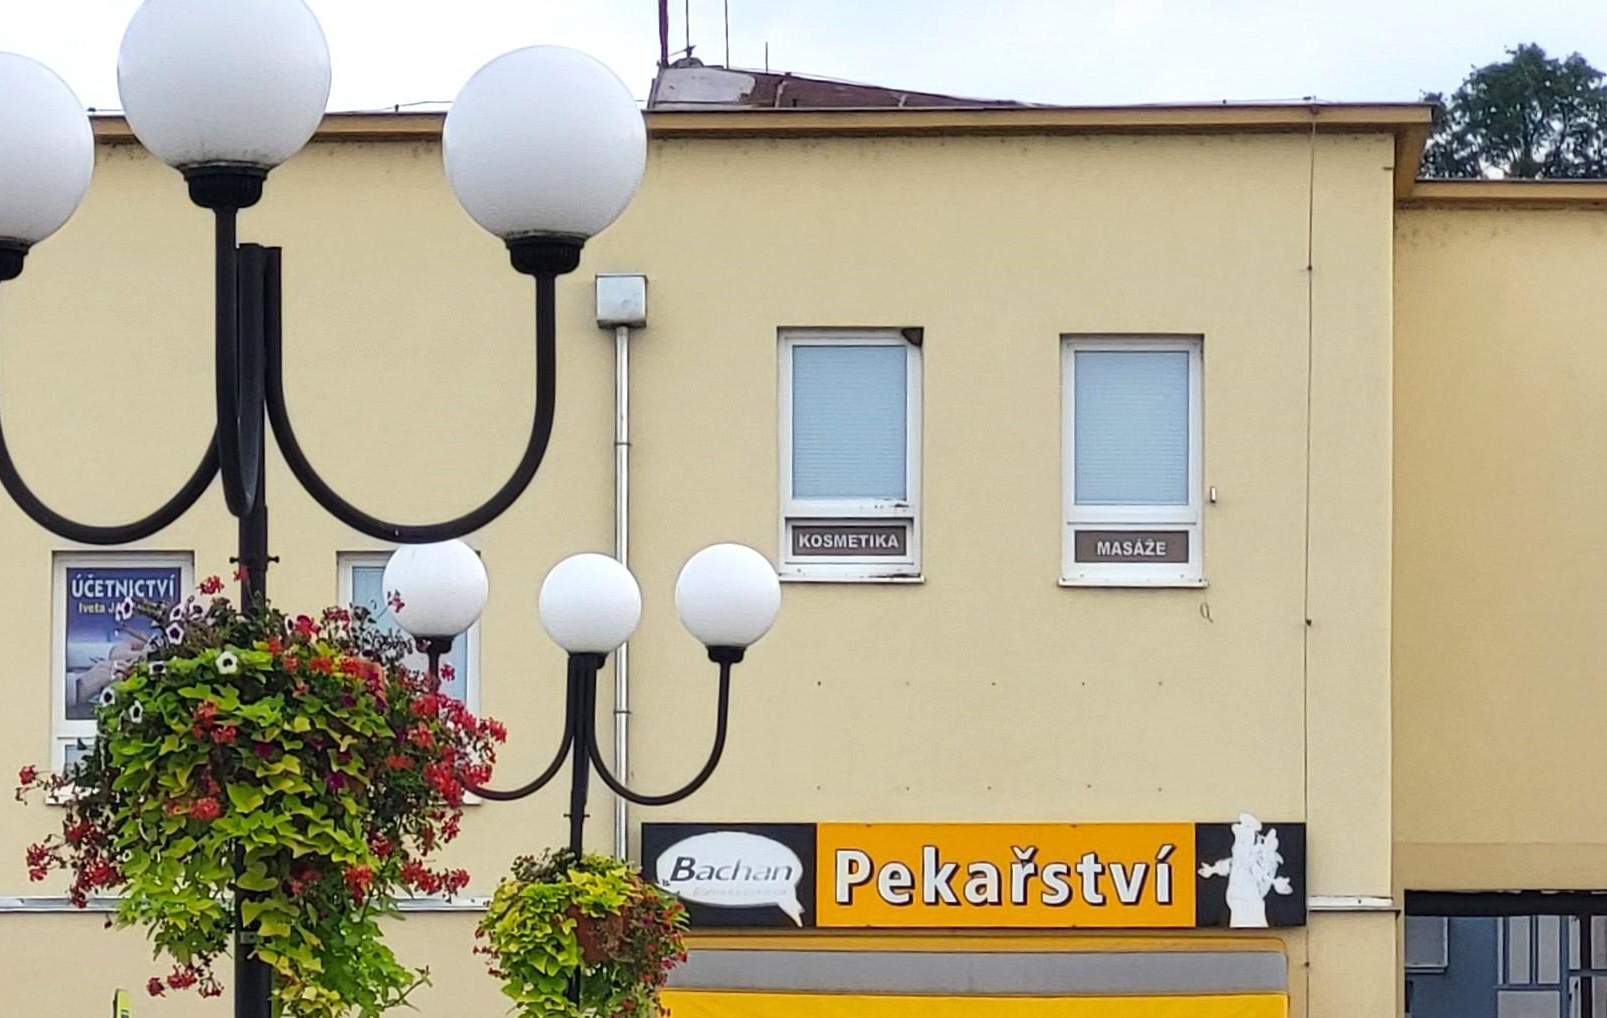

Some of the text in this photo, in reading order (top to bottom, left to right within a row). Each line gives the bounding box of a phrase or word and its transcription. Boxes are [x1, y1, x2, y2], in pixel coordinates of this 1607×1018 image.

[798, 533, 900, 549] KOSMETIKA
[1096, 538, 1168, 557] MASÁŽE
[71, 574, 176, 598] ÚČETNICTVÍ
[78, 602, 106, 614] Iveta
[669, 855, 793, 882] Bachan
[834, 843, 1177, 907] Pekařství
